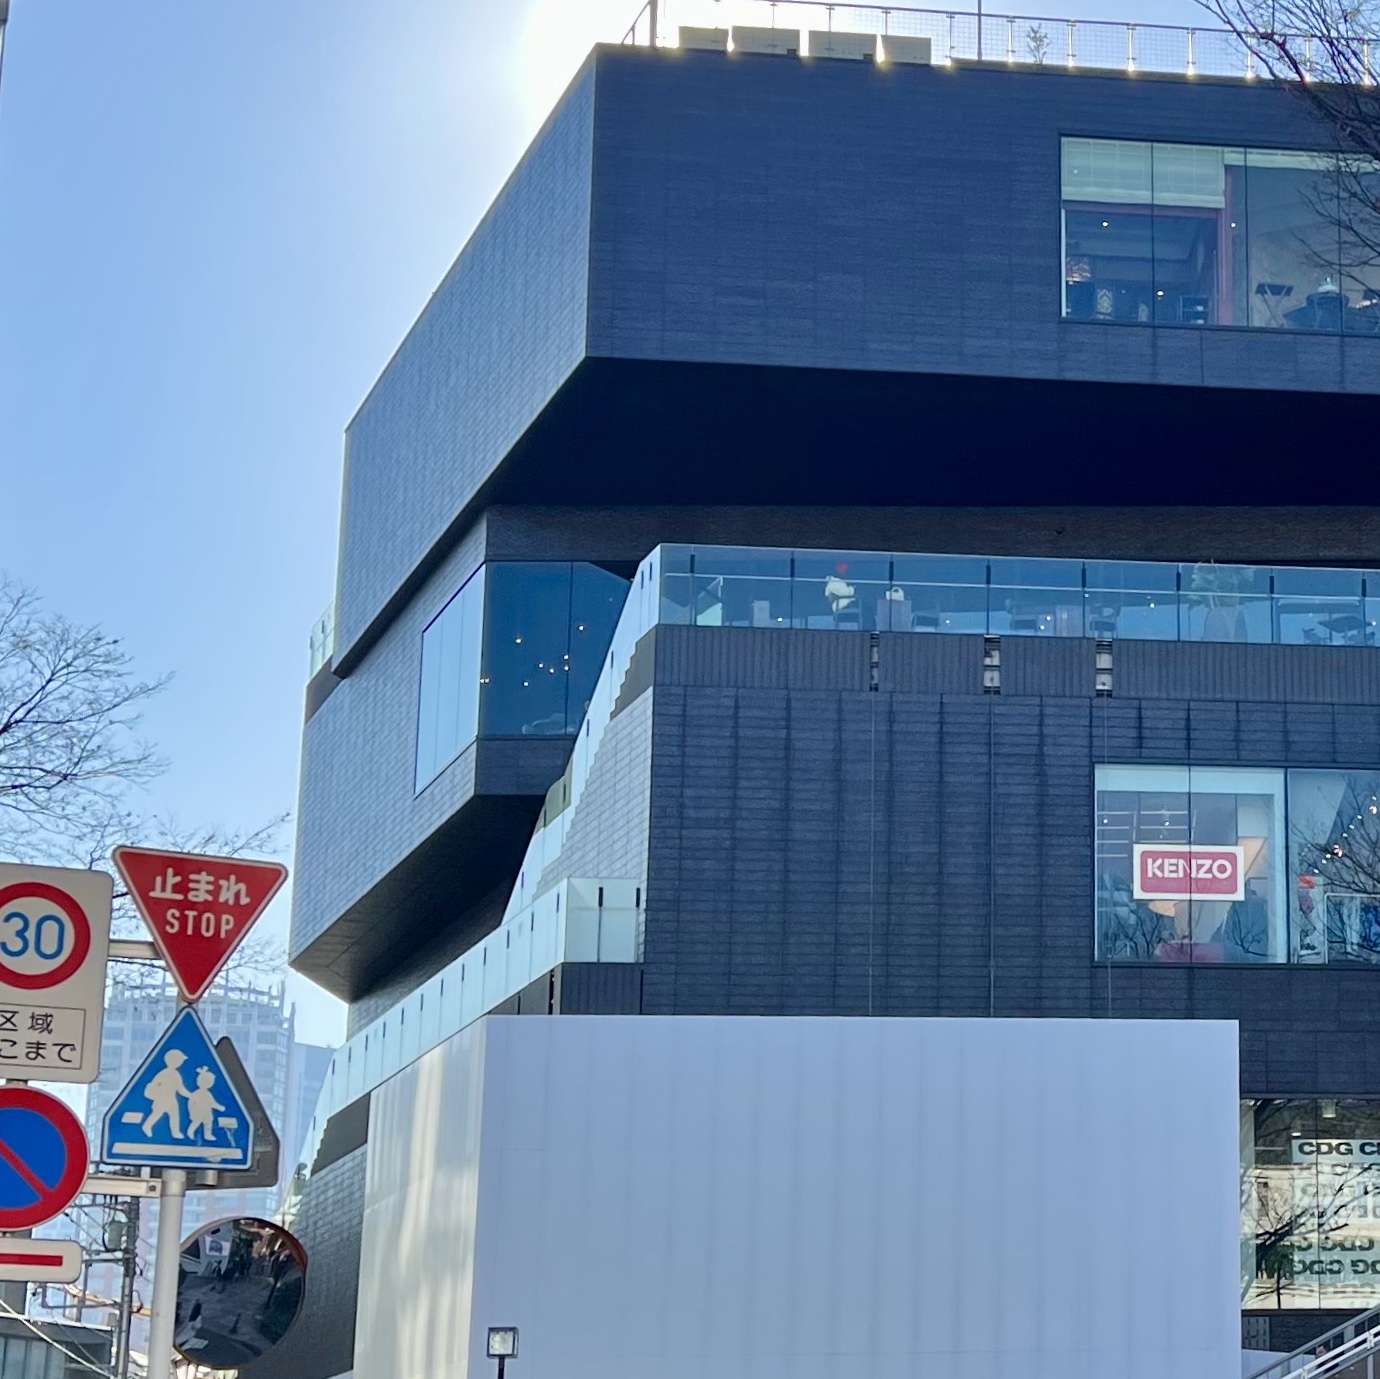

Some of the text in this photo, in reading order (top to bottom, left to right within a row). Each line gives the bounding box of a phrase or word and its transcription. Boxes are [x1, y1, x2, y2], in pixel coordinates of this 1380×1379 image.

[1146, 857, 1233, 880] KENZO
[149, 868, 251, 907] 止まれ
[165, 908, 235, 939] STOP
[0, 912, 65, 960] 30
[0, 1010, 54, 1034] 区域
[0, 1039, 77, 1063] こまで
[1298, 1141, 1353, 1156] CDG
